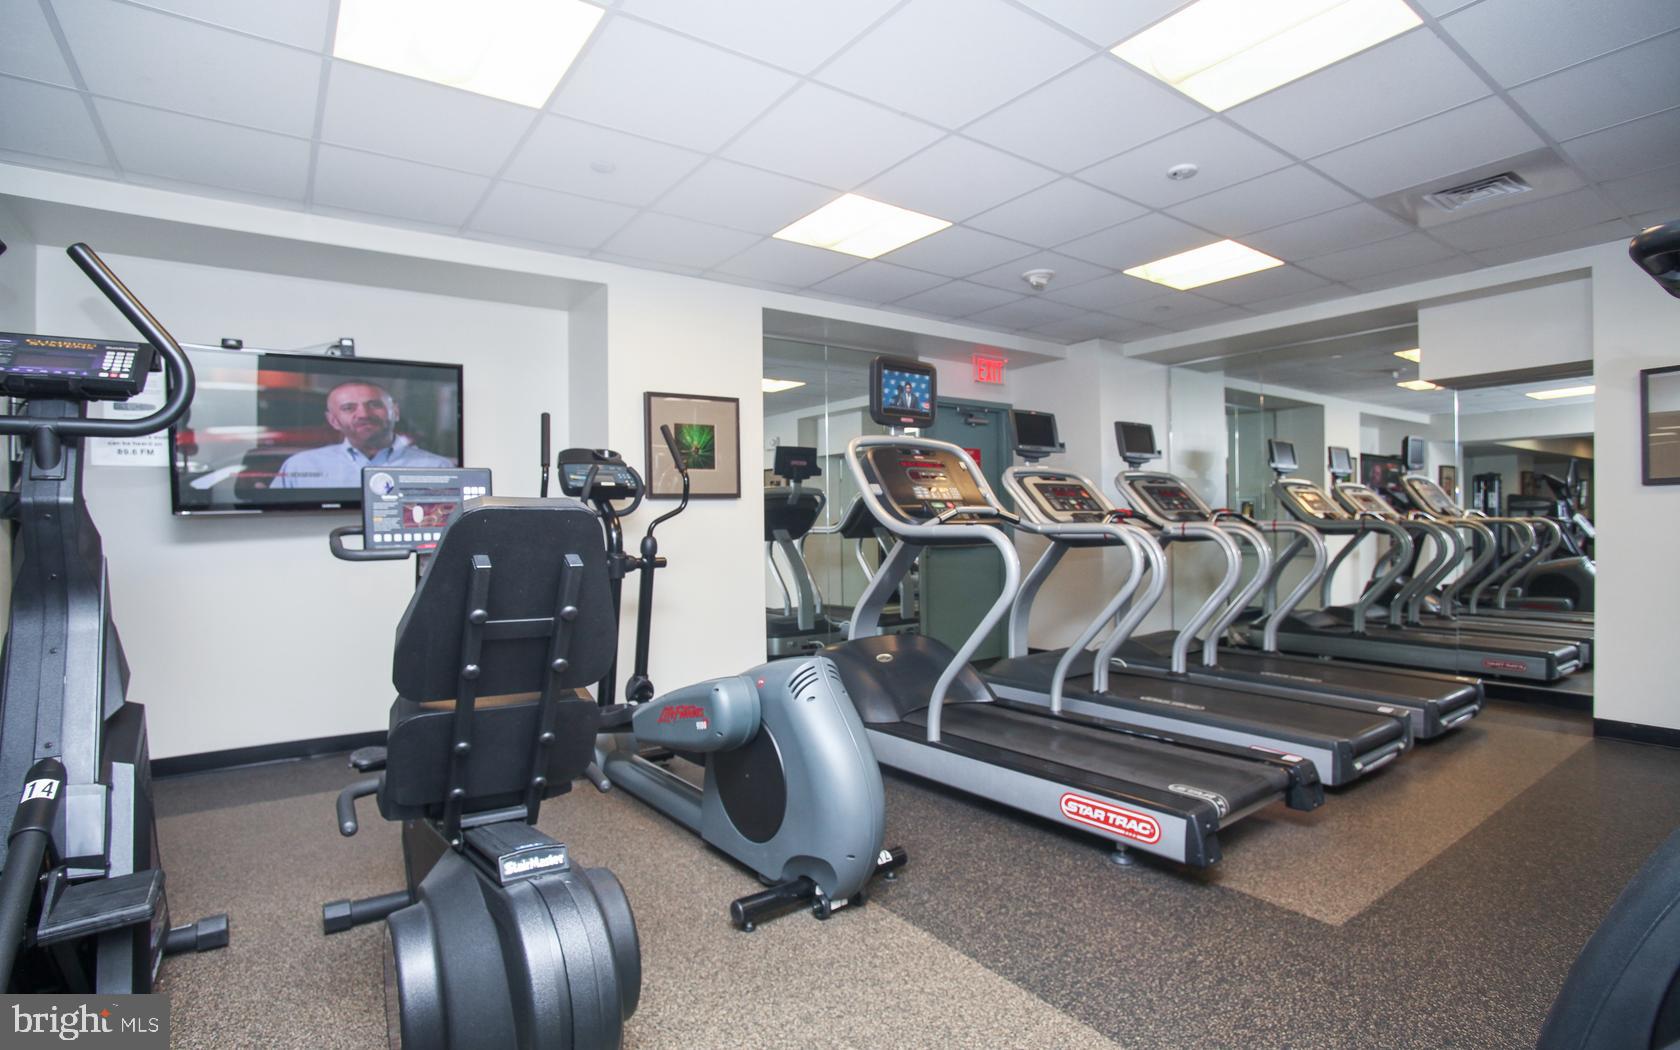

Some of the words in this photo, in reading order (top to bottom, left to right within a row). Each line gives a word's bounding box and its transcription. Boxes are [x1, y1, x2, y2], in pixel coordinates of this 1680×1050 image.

[977, 358, 1003, 384] EXIT
[28, 781, 54, 798] 14
[1066, 800, 1105, 822] STAR
[1106, 811, 1152, 835] TRAC
